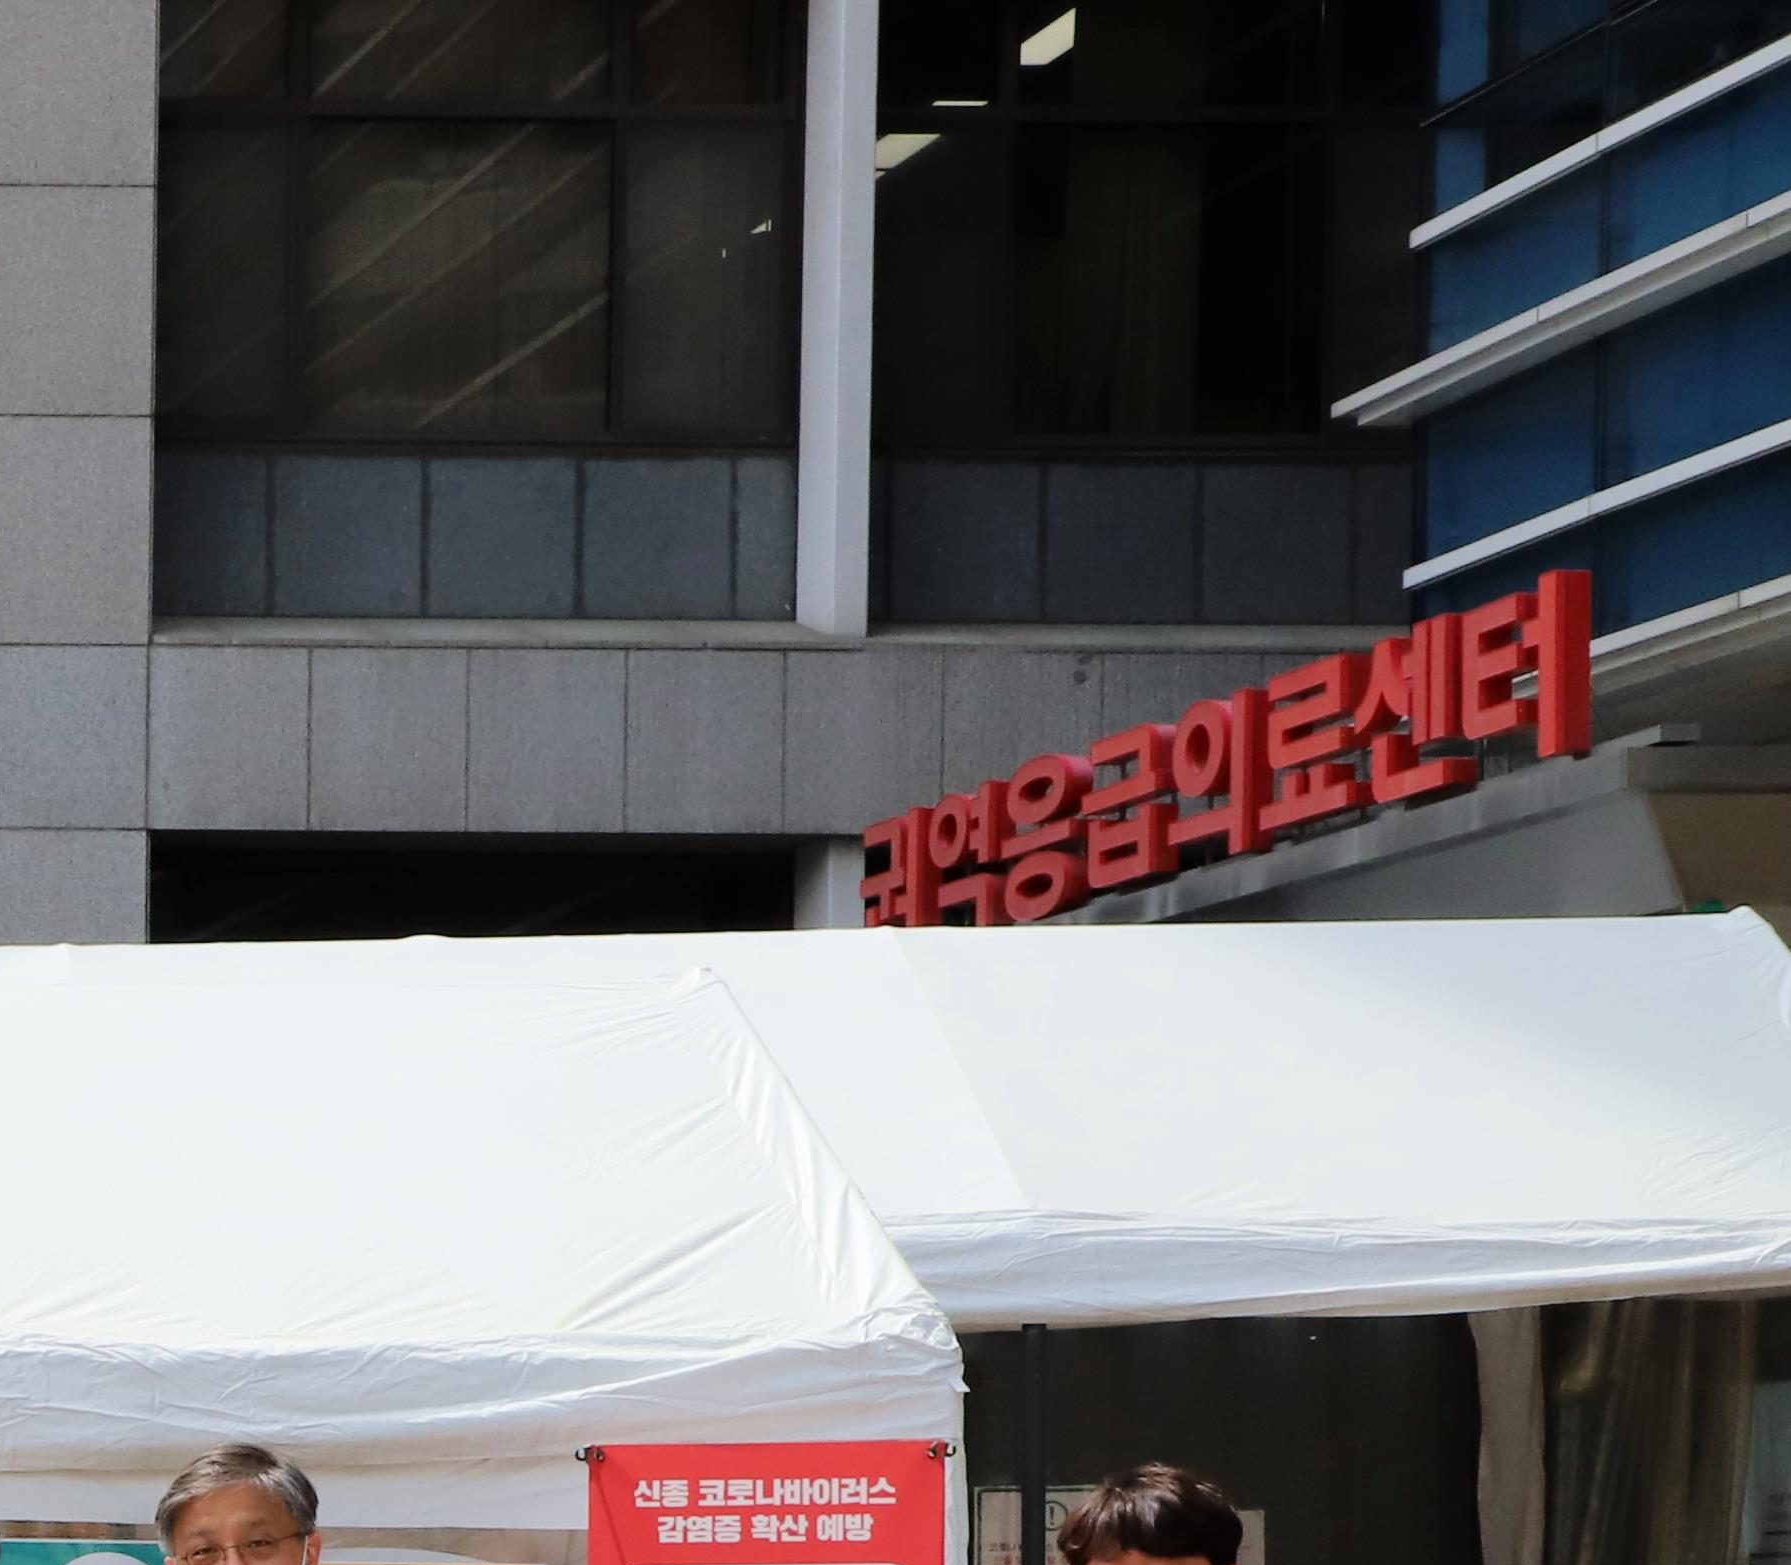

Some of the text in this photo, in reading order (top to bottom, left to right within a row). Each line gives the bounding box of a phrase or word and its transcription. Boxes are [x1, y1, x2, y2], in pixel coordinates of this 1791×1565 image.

[861, 568, 1592, 926] 권역응급의료센터
[634, 1477, 897, 1507] 신종 코로나바이러스
[657, 1513, 874, 1543] 감염증 확산 예방
